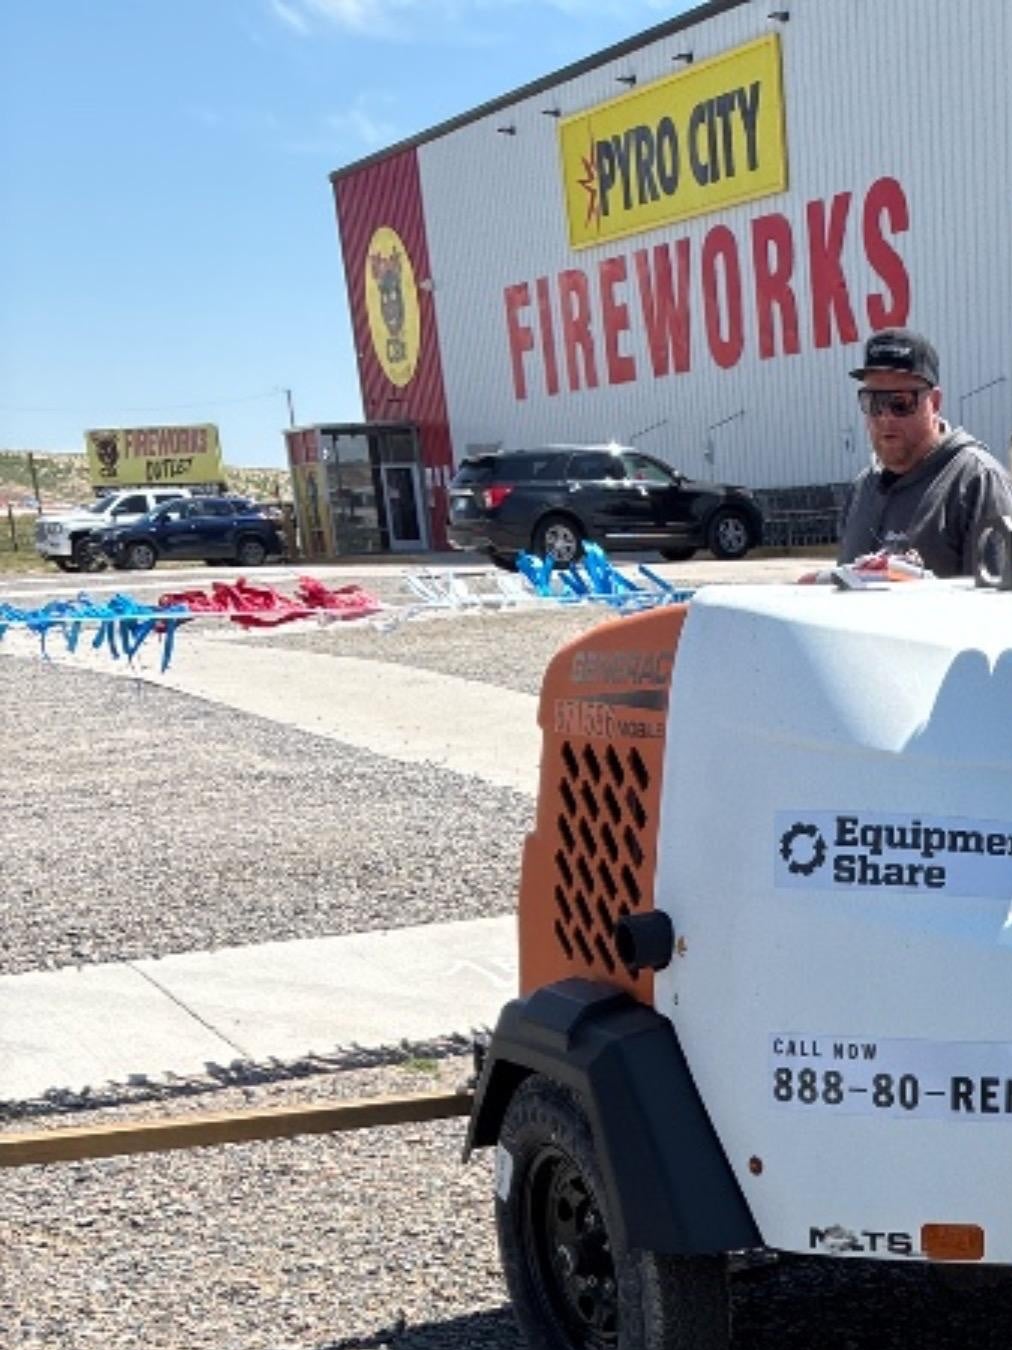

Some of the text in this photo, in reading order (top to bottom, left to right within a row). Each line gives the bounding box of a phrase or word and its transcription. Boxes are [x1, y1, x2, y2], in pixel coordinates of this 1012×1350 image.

[596, 81, 761, 216] PYRO CITY
[503, 176, 911, 400] FIREWORKS
[833, 854, 946, 888] Share
[773, 1038, 878, 1060] CALL NOW
